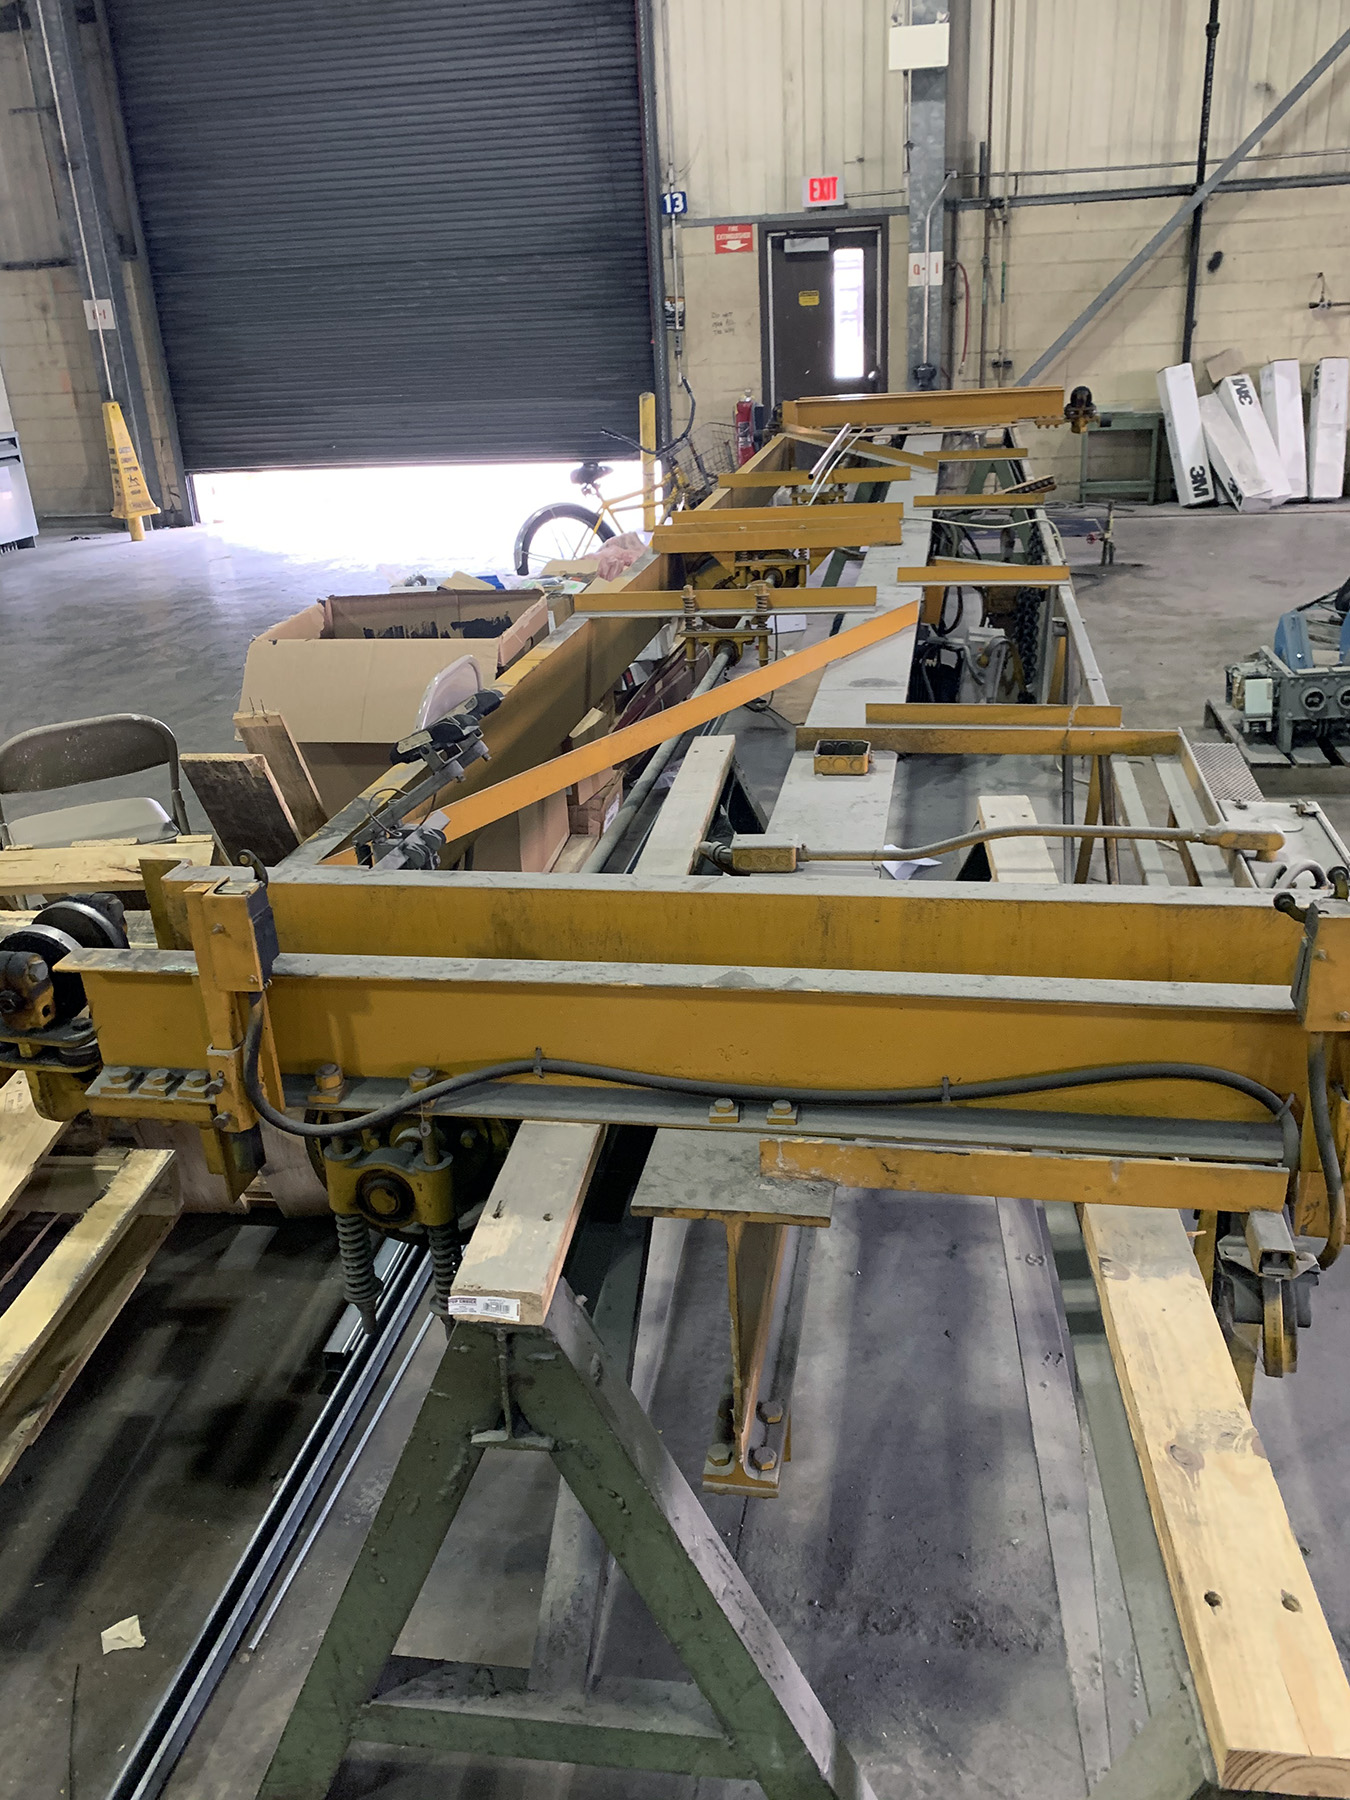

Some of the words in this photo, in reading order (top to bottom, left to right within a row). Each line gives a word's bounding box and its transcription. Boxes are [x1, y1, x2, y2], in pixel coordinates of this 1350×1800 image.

[809, 176, 839, 202] EXIT
[664, 193, 684, 213] 13
[1231, 378, 1253, 406] 3M
[1190, 465, 1209, 498] 3M
